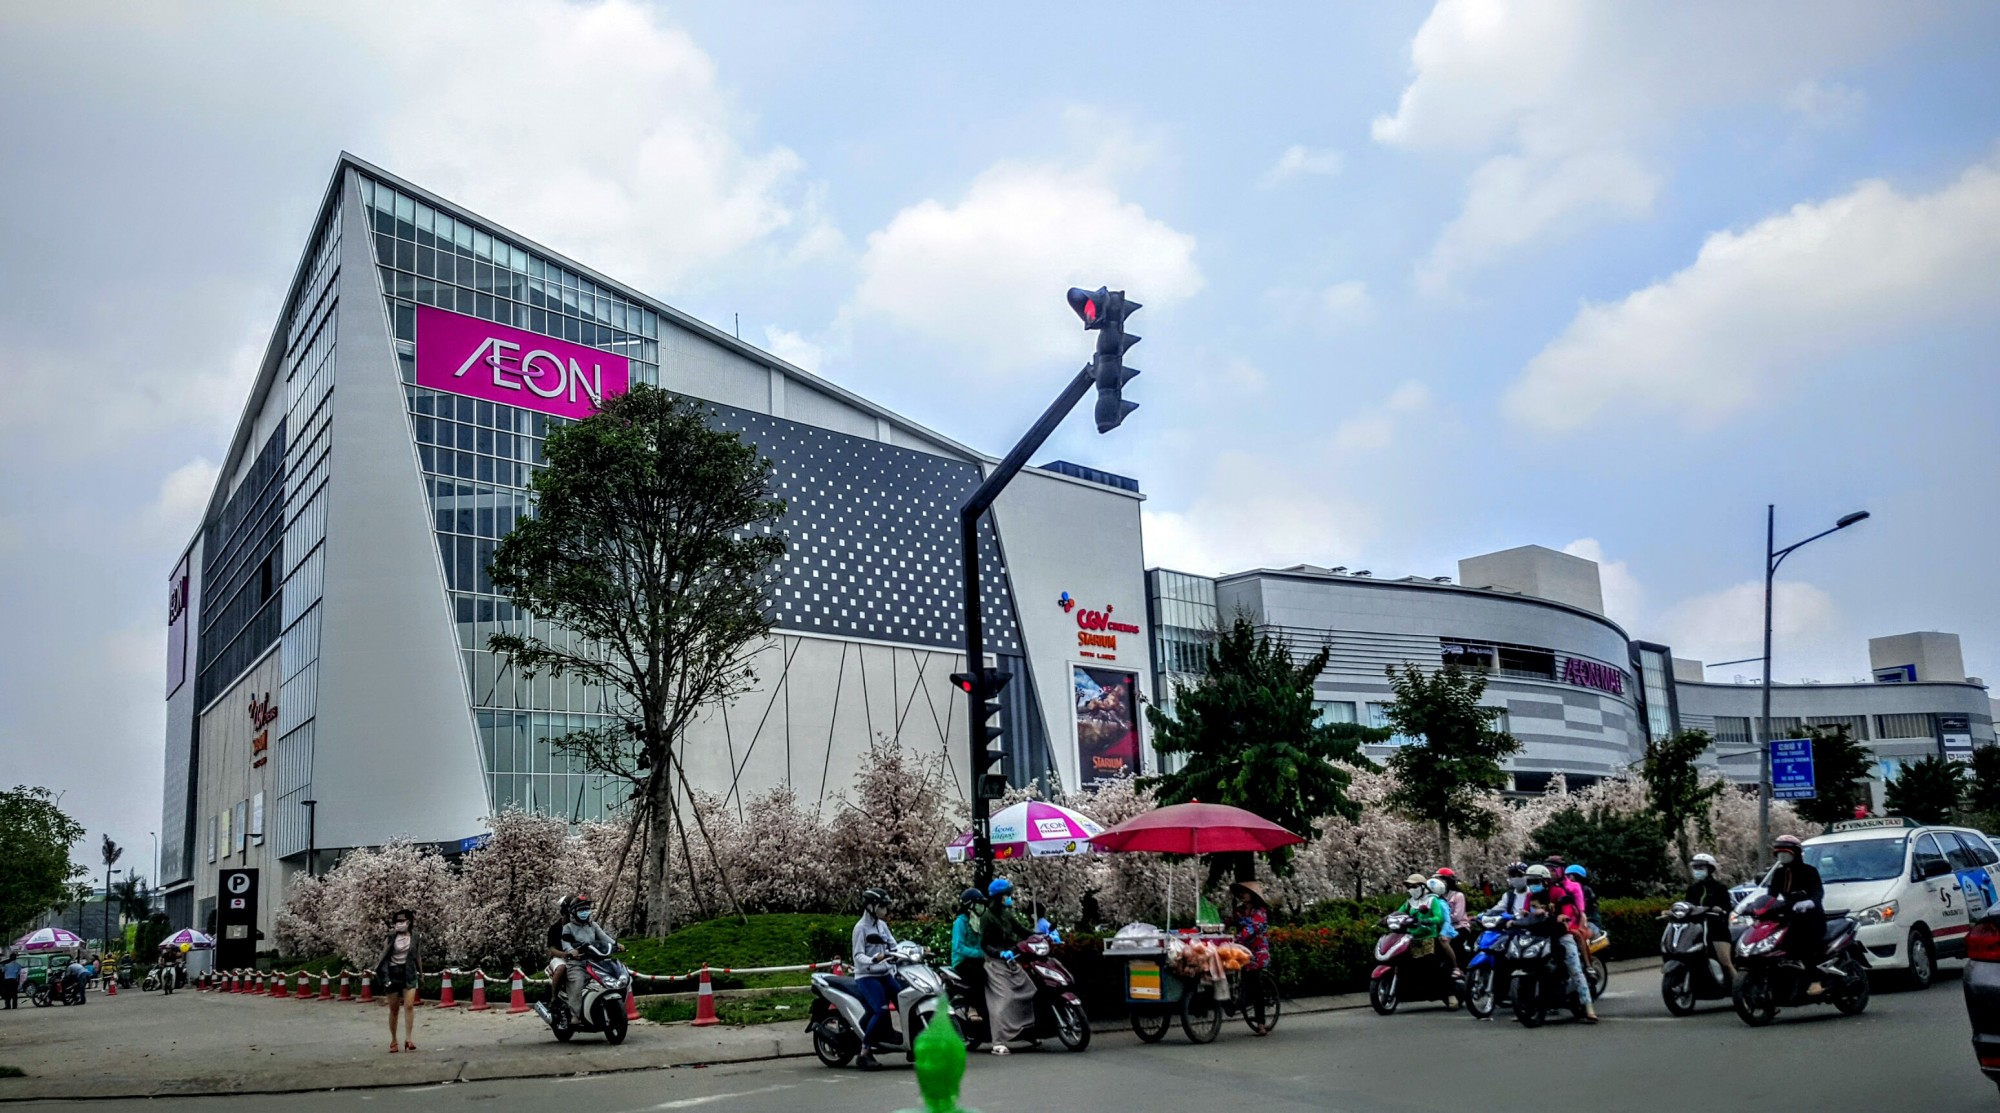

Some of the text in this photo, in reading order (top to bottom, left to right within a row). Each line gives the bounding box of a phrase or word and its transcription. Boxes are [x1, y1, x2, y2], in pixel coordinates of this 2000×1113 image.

[1077, 608, 1109, 631] CGV
[1078, 630, 1117, 651] STARIUM
[1847, 818, 1901, 830] VINASUN TAXI
[233, 876, 245, 890] P
